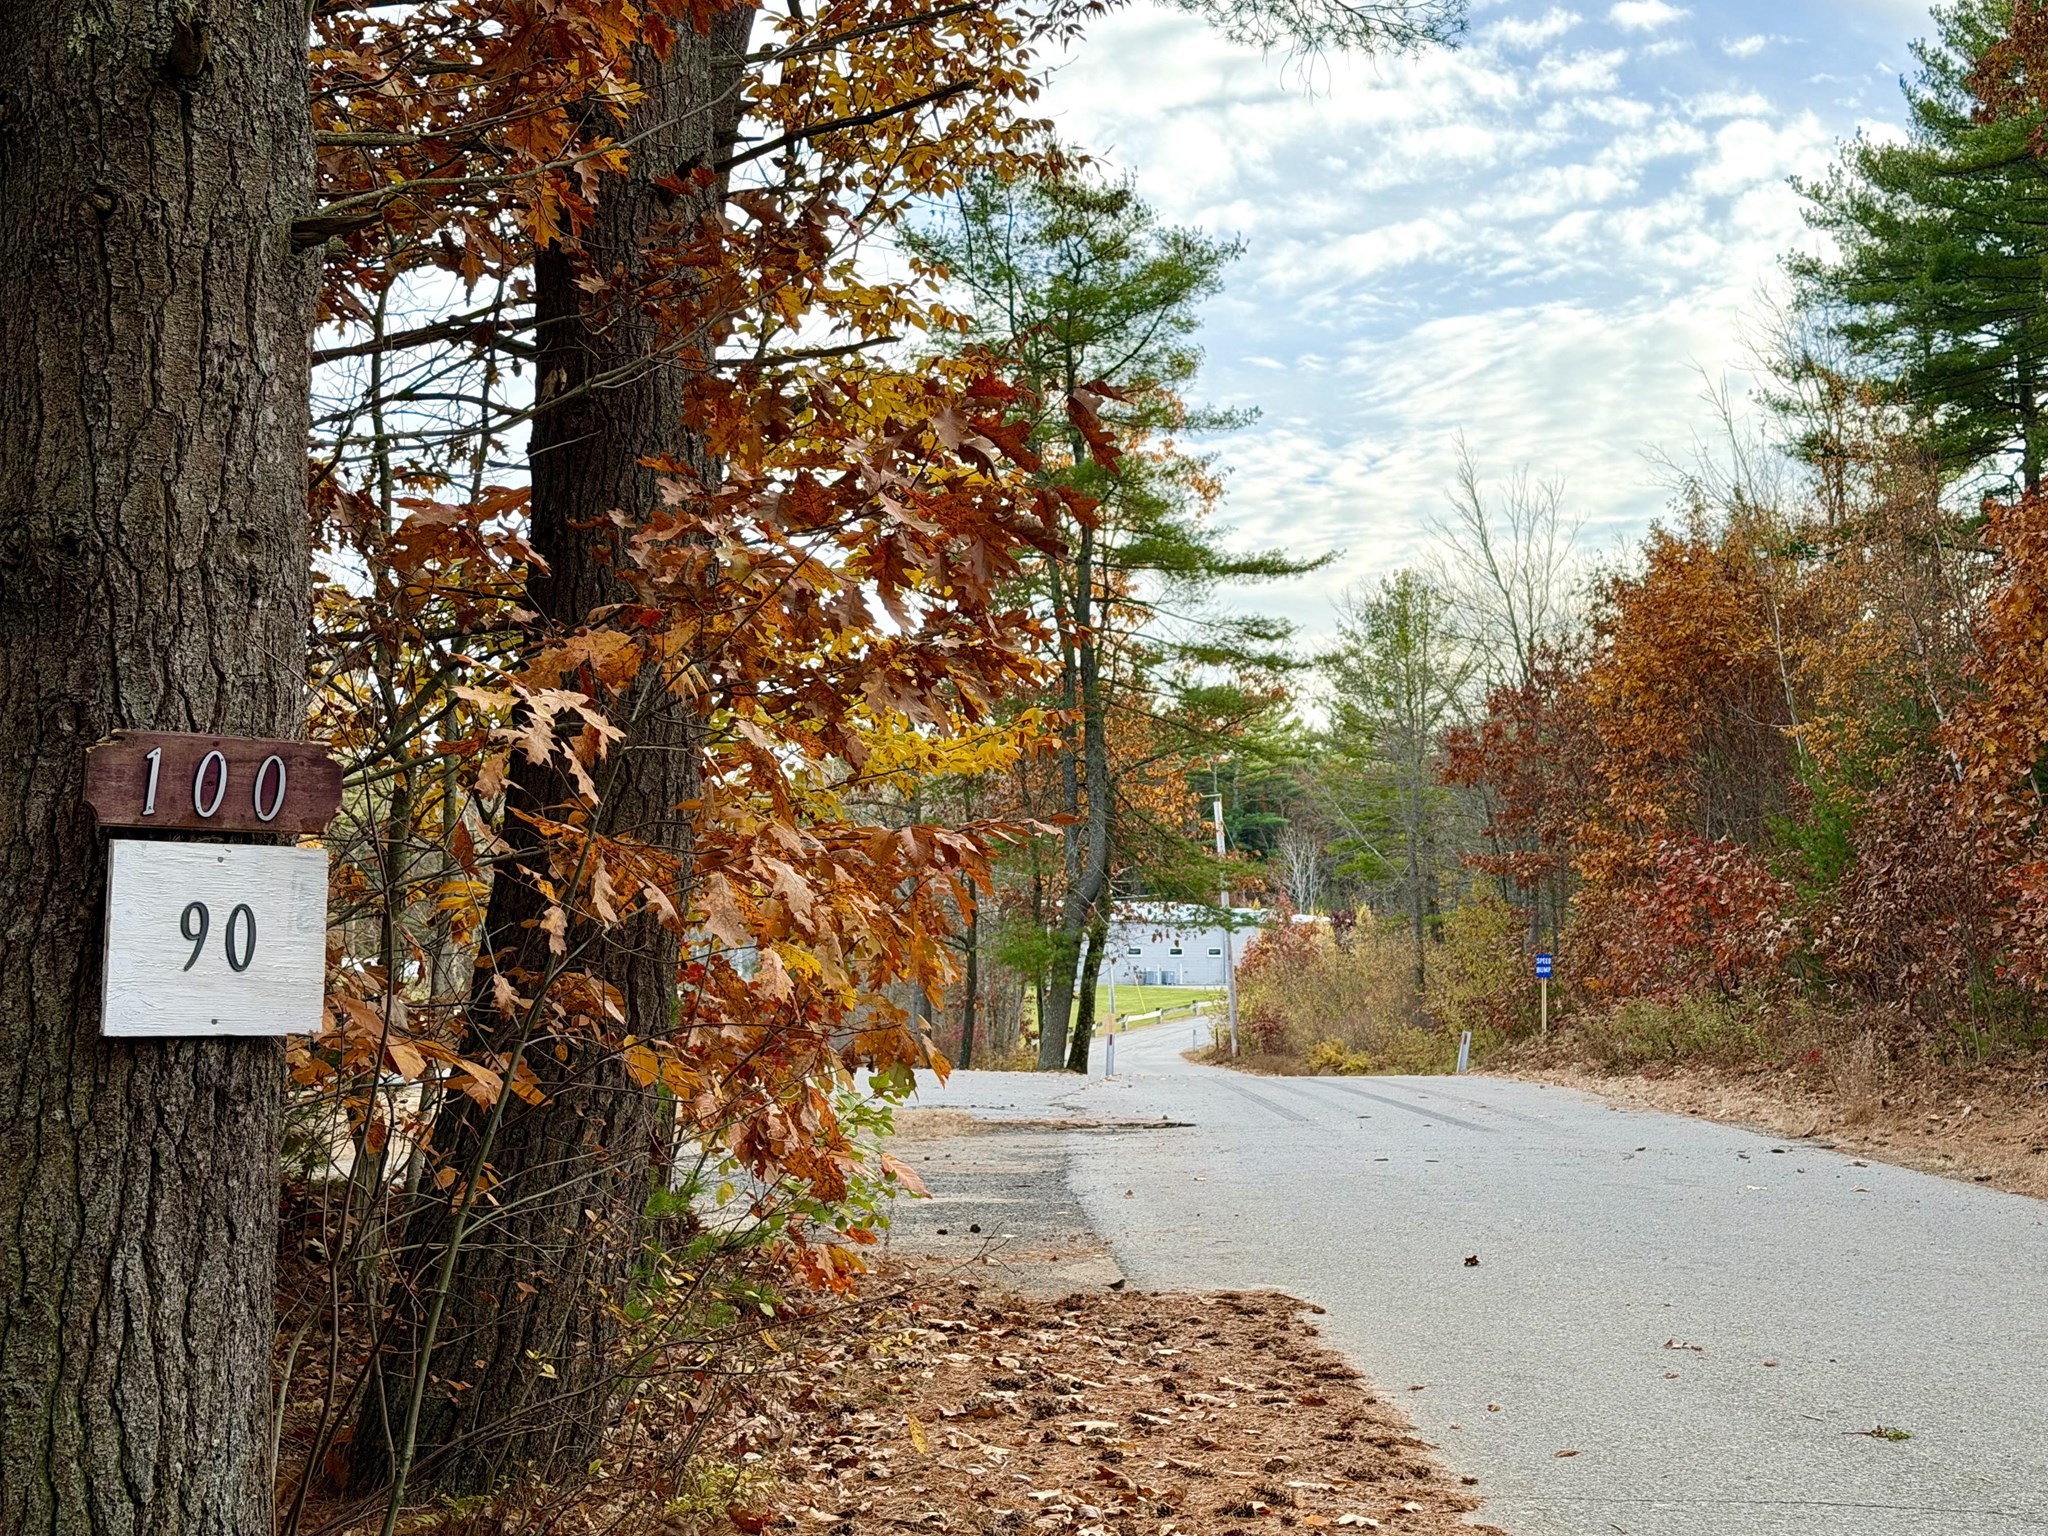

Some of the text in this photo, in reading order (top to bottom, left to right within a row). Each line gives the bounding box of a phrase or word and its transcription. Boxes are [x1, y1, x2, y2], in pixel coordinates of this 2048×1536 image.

[142, 747, 286, 822] 100
[180, 901, 256, 972] 90
[1536, 957, 1551, 965] SPEED
[1536, 966, 1551, 974] BUMP
